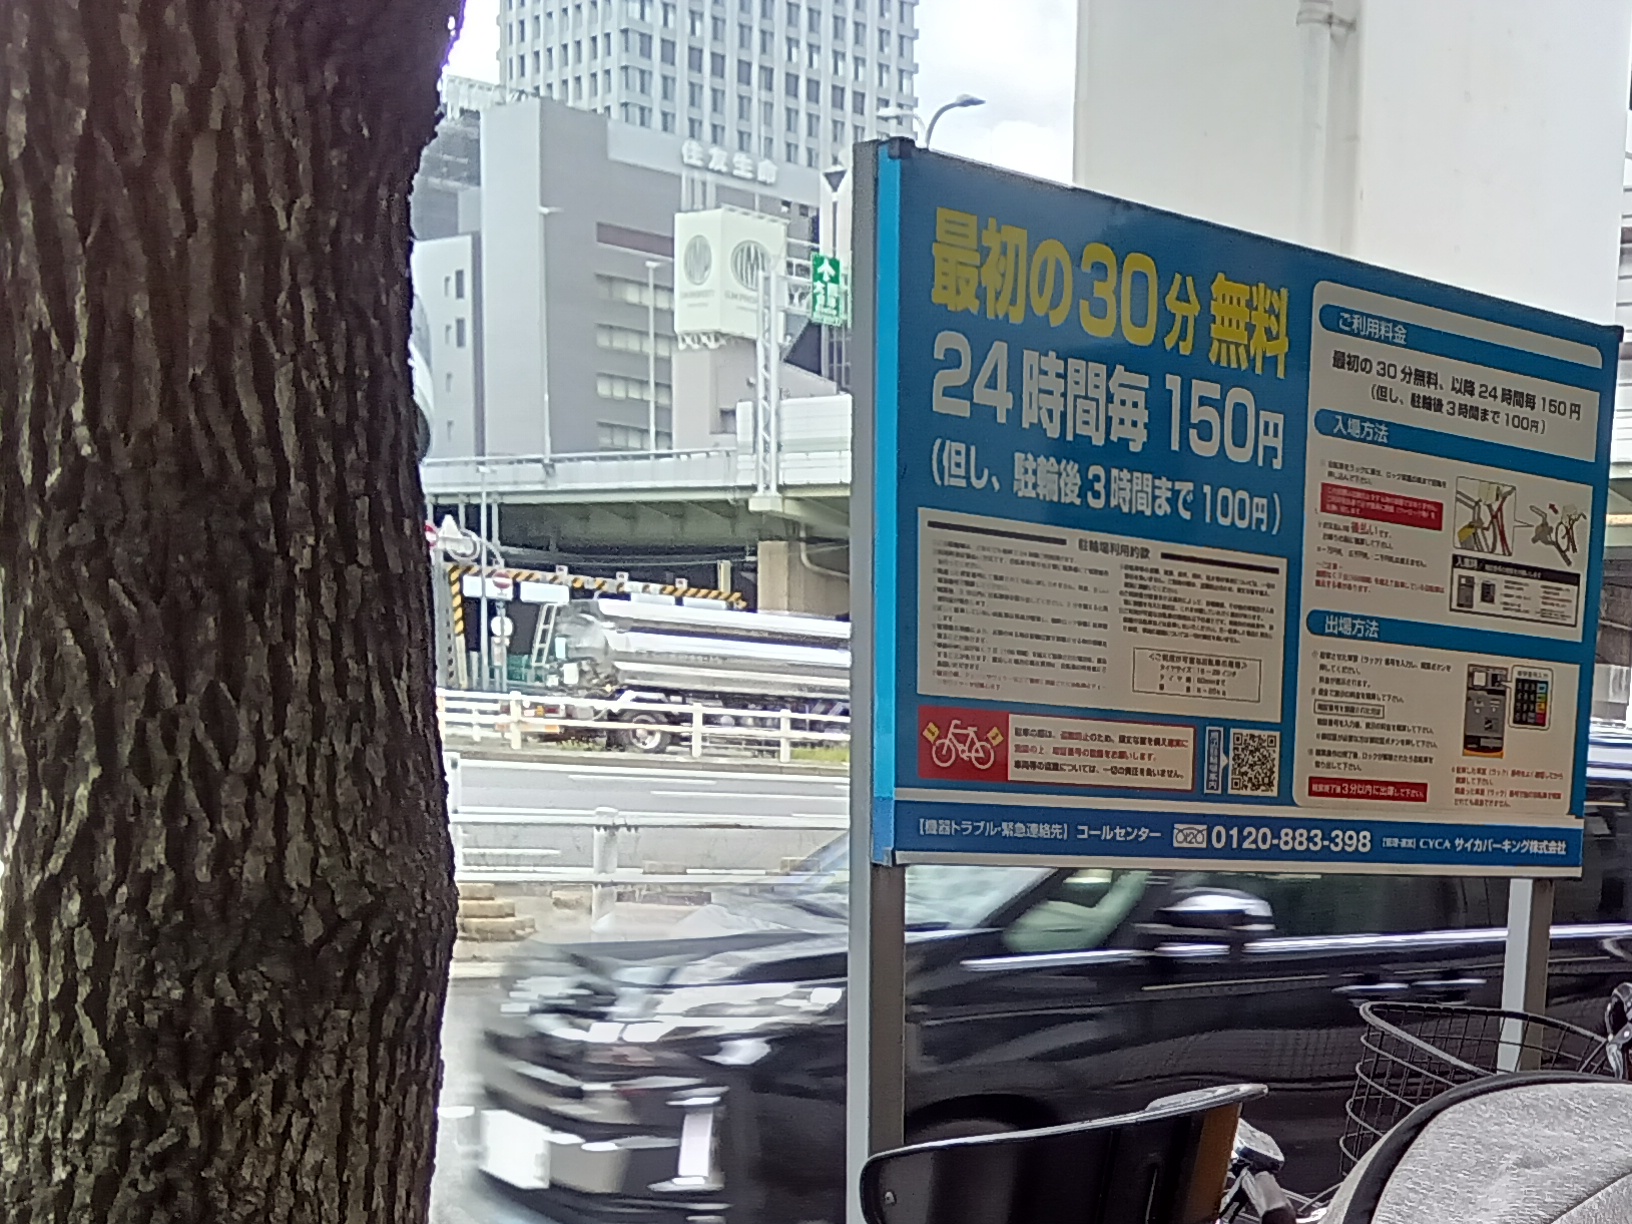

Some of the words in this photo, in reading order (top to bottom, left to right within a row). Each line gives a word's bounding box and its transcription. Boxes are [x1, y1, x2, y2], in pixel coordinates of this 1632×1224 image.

[682, 139, 777, 184] 住友生命
[1338, 312, 1407, 345] ご利用料金
[1333, 415, 1389, 443] 入場方法
[1325, 615, 1379, 638] 出場方法
[1077, 825, 1161, 841] コールセンター
[1212, 826, 1371, 852] 0120-883-398
[1419, 839, 1451, 850] CYCA
